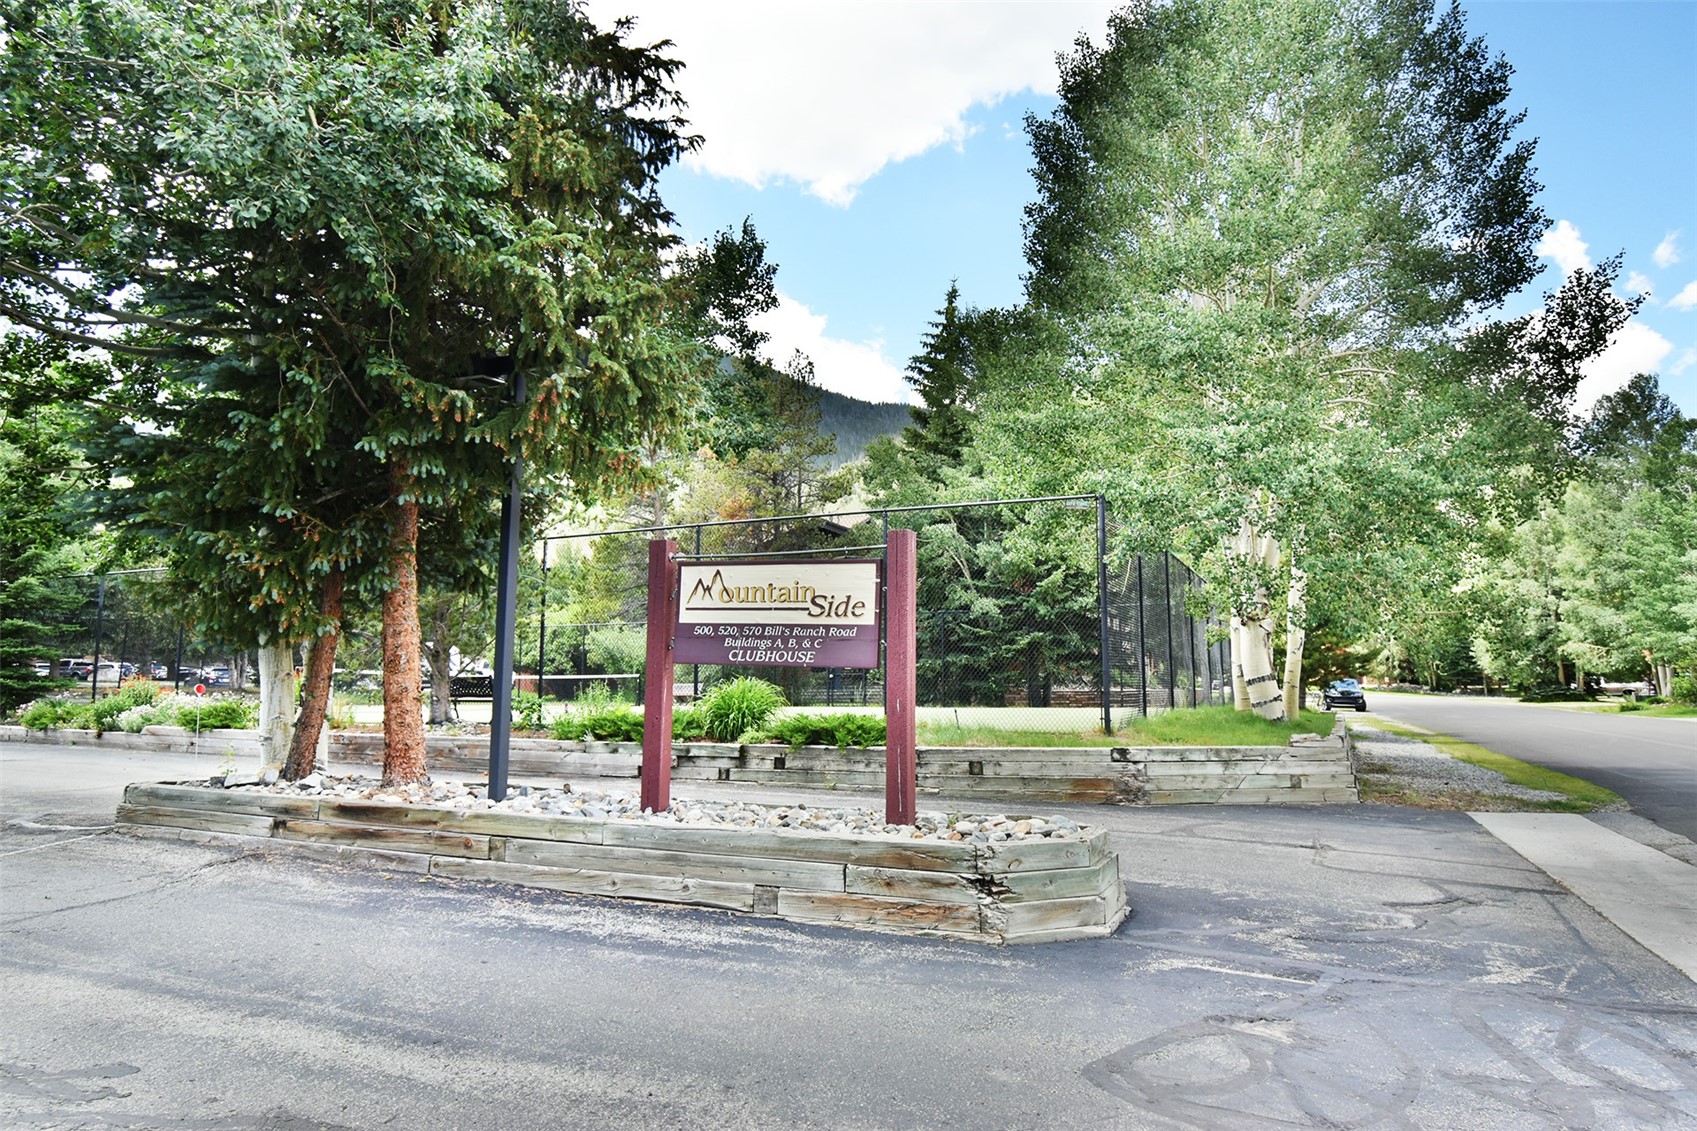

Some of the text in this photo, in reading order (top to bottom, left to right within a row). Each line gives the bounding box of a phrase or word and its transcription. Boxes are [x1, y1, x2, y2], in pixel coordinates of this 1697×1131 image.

[687, 569, 816, 604] Mountain
[807, 595, 866, 618] Side
[694, 625, 857, 637] 500, 520, 570 Bill's Ranch Road
[724, 637, 823, 650] Buildings A, B, & C
[728, 649, 816, 663] CLUBHOUSE
